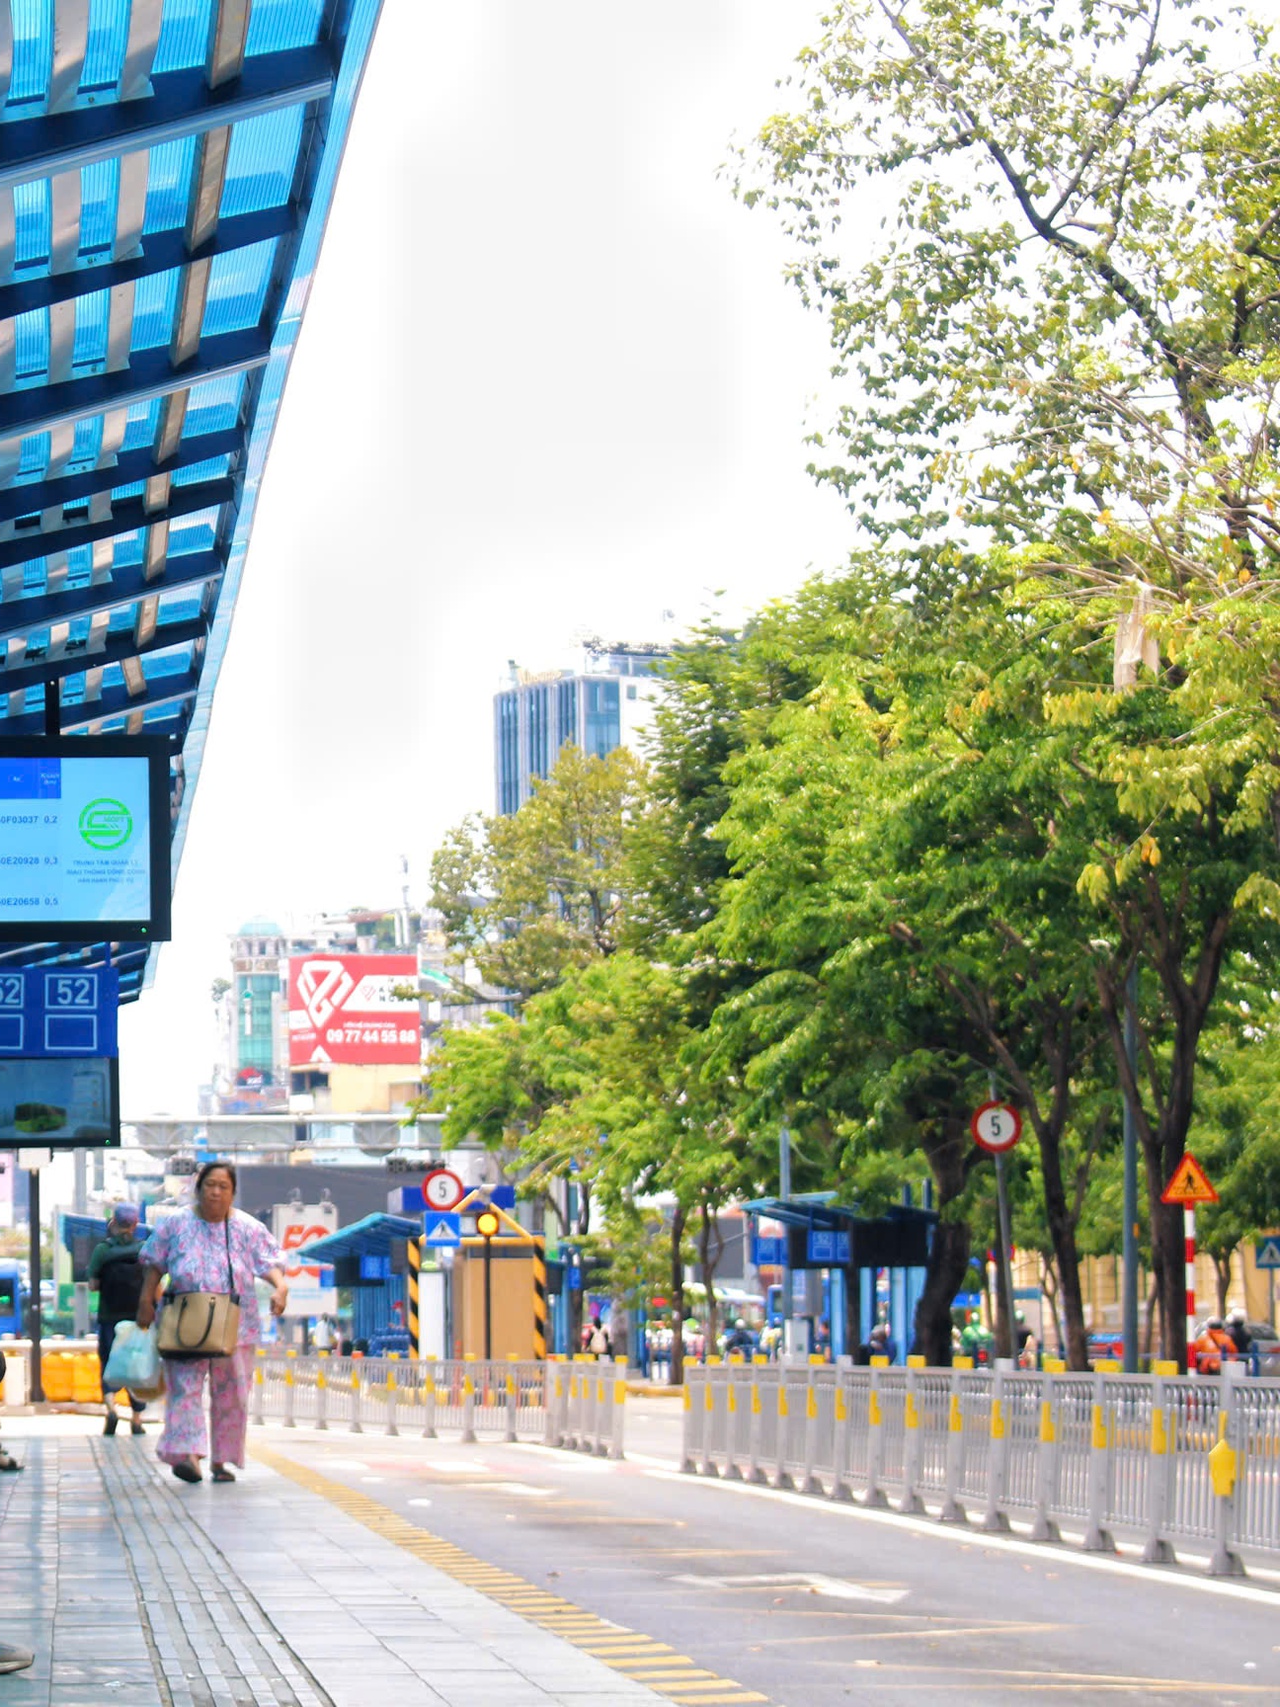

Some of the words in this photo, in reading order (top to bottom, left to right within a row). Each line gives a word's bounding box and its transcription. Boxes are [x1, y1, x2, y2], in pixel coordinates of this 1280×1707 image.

[56, 979, 90, 1005] 52
[325, 1028, 344, 1044] 09
[344, 1028, 362, 1044] 77
[361, 1028, 379, 1044] 44
[990, 1114, 1001, 1137] 5
[438, 1180, 447, 1199] 5
